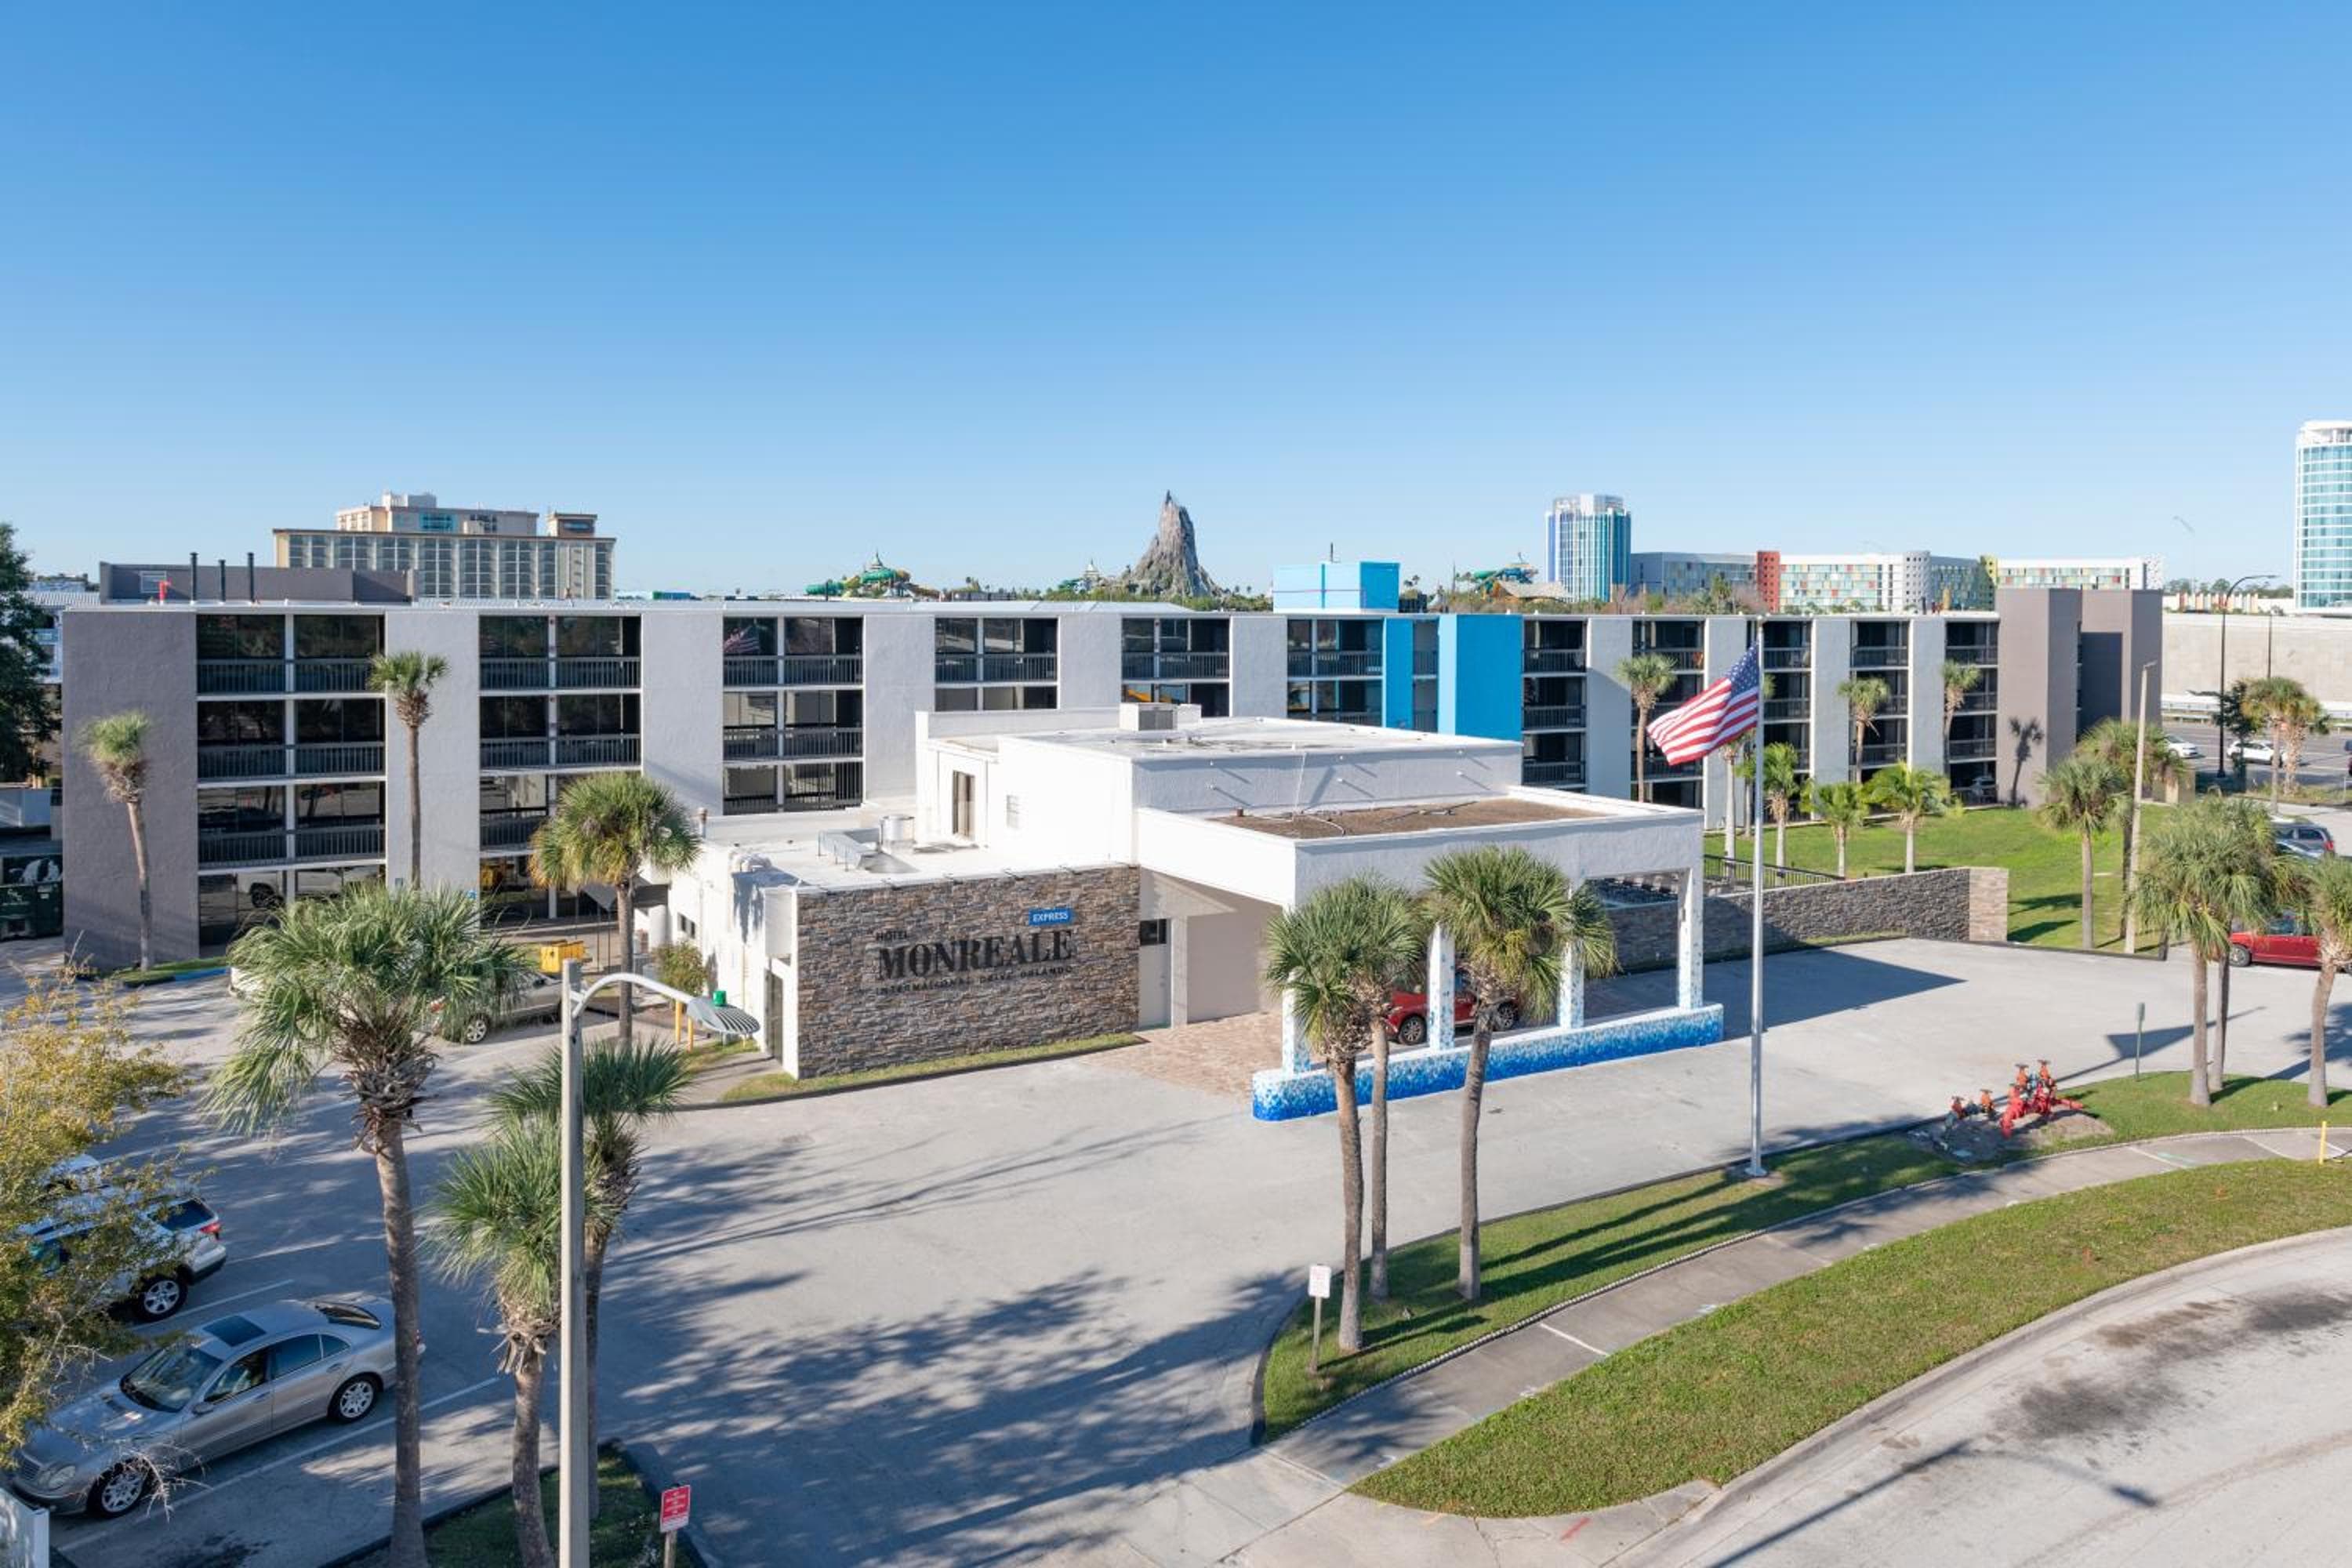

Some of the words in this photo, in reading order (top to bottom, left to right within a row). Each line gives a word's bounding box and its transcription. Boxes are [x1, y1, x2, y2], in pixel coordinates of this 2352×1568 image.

[1032, 911, 1069, 923] EXPRESS
[876, 931, 909, 941] HOTEL
[879, 930, 1073, 980] MONREALE
